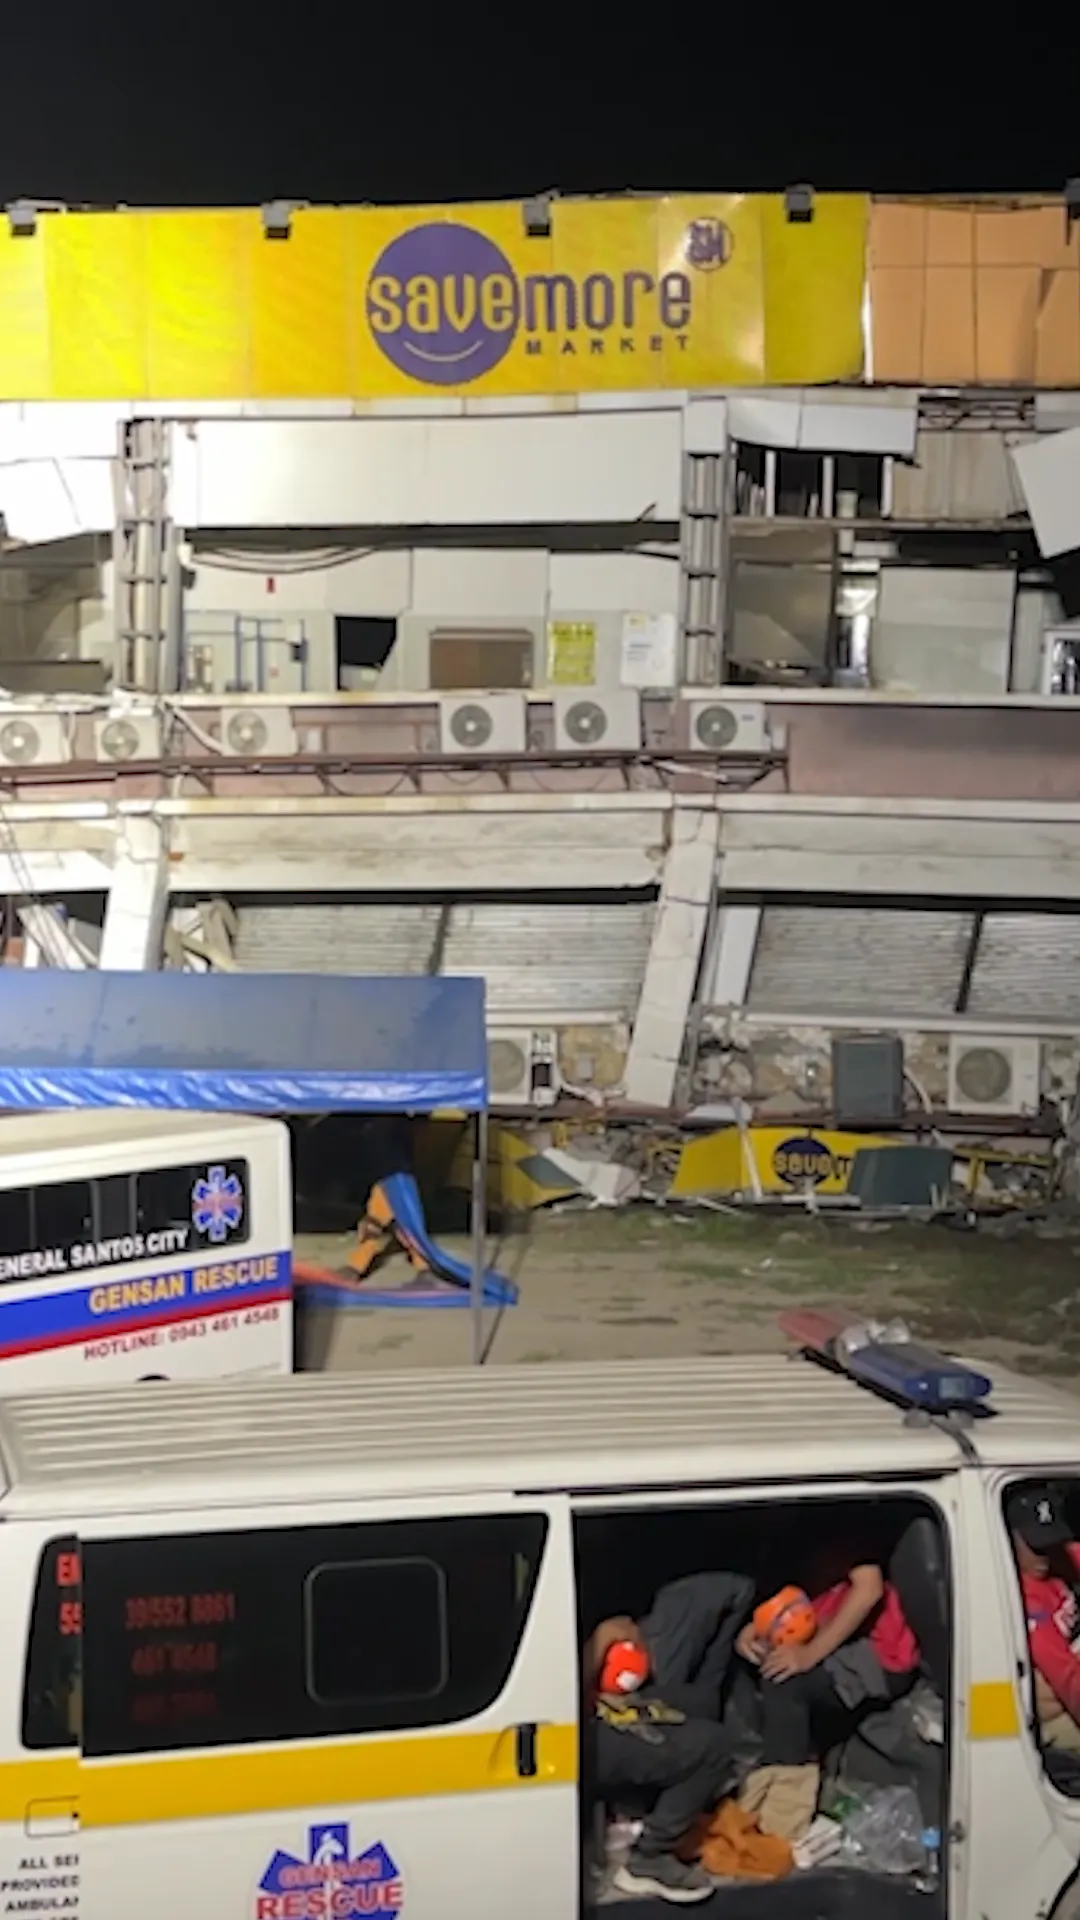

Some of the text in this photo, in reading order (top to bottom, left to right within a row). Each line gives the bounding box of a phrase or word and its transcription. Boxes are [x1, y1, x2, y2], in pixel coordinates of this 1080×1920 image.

[369, 271, 691, 333] savemore
[525, 335, 688, 355] MARKET
[70, 1234, 144, 1268] SANTOS
[147, 1228, 188, 1252] CITY
[89, 1256, 279, 1314] GENSAN RESCUE
[256, 1882, 403, 1920] RESCUE
